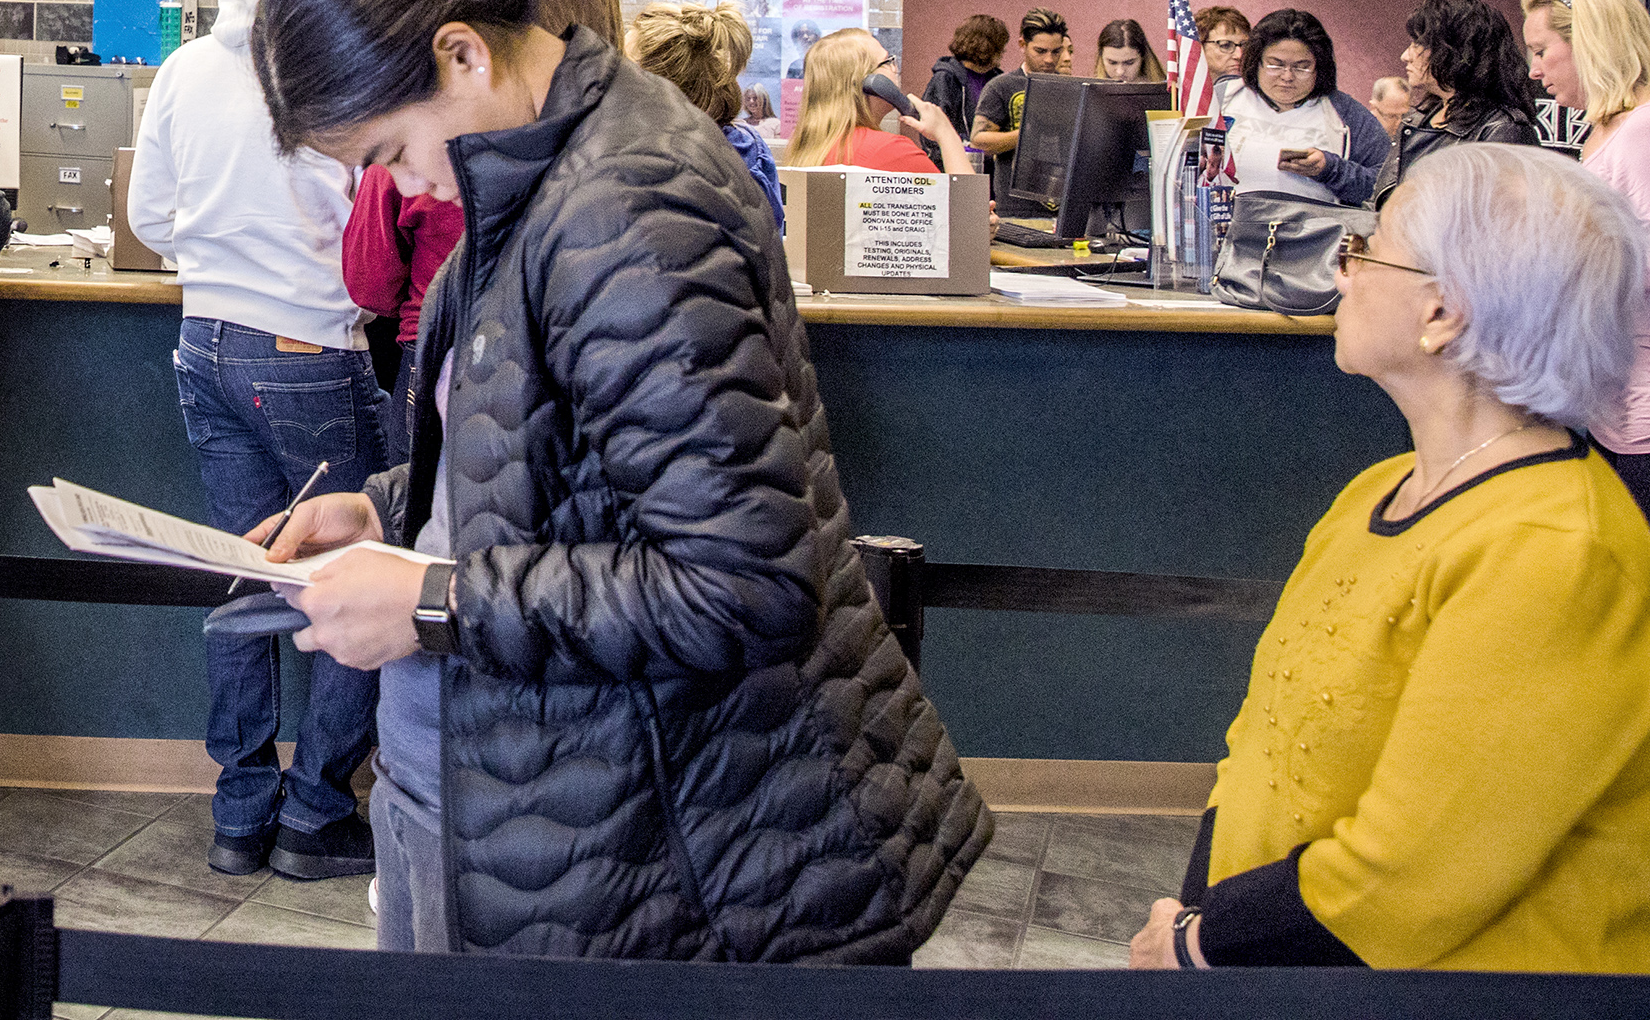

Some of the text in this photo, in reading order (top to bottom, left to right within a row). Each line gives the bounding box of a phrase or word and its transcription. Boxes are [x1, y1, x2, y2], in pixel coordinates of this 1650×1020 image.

[63, 171, 77, 179] FAX
[865, 176, 912, 184] ATTENTION
[872, 186, 924, 194] CUSTOMERS
